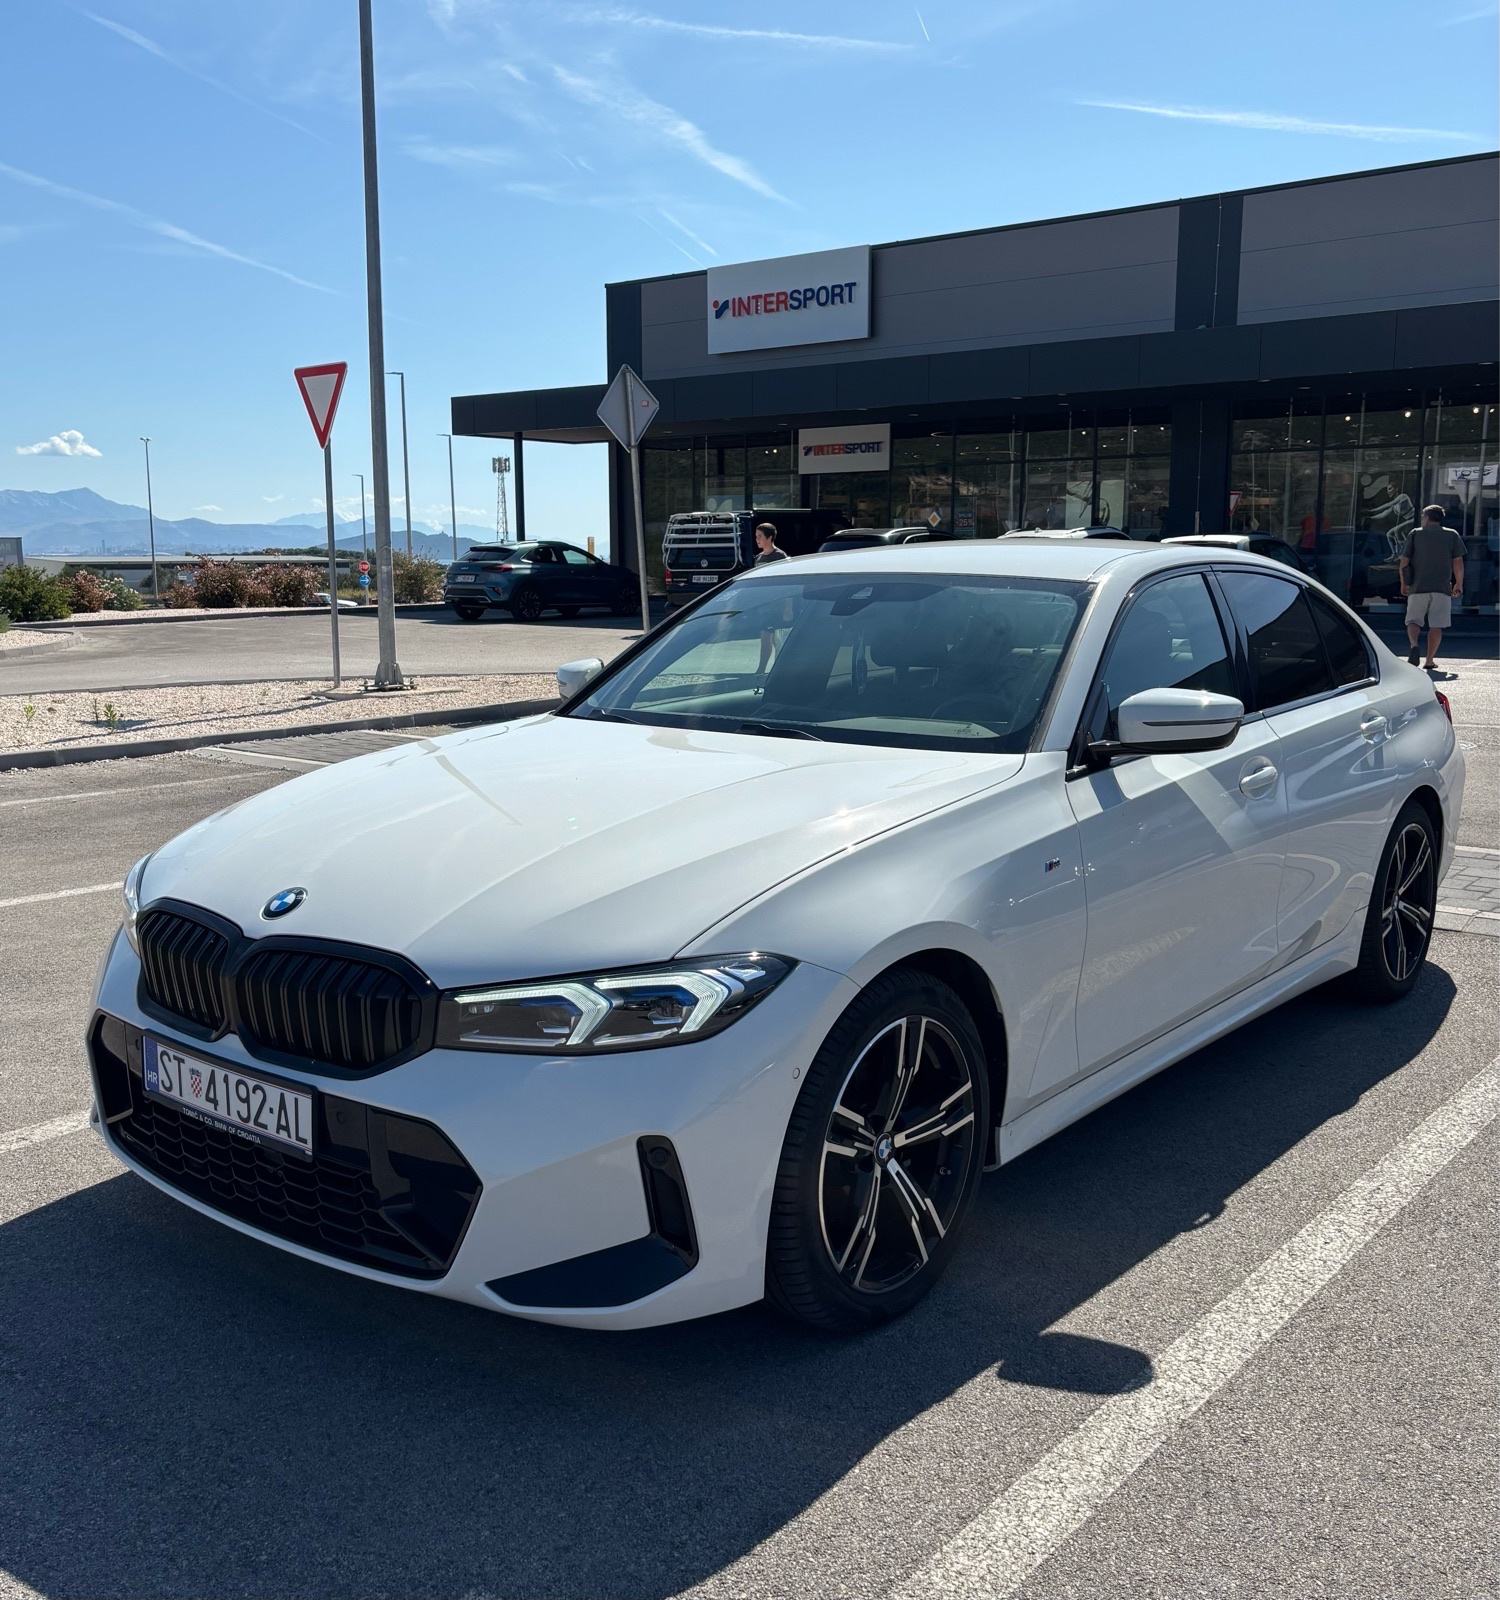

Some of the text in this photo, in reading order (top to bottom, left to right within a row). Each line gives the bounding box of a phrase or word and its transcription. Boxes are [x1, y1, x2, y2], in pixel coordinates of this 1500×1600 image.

[732, 282, 857, 317] INTERSPORT
[814, 441, 884, 456] INTERSPORT
[146, 1070, 158, 1084] HR
[160, 1050, 185, 1097] ST
[228, 1126, 236, 1135] OF
[236, 1129, 262, 1145] CROATIA
